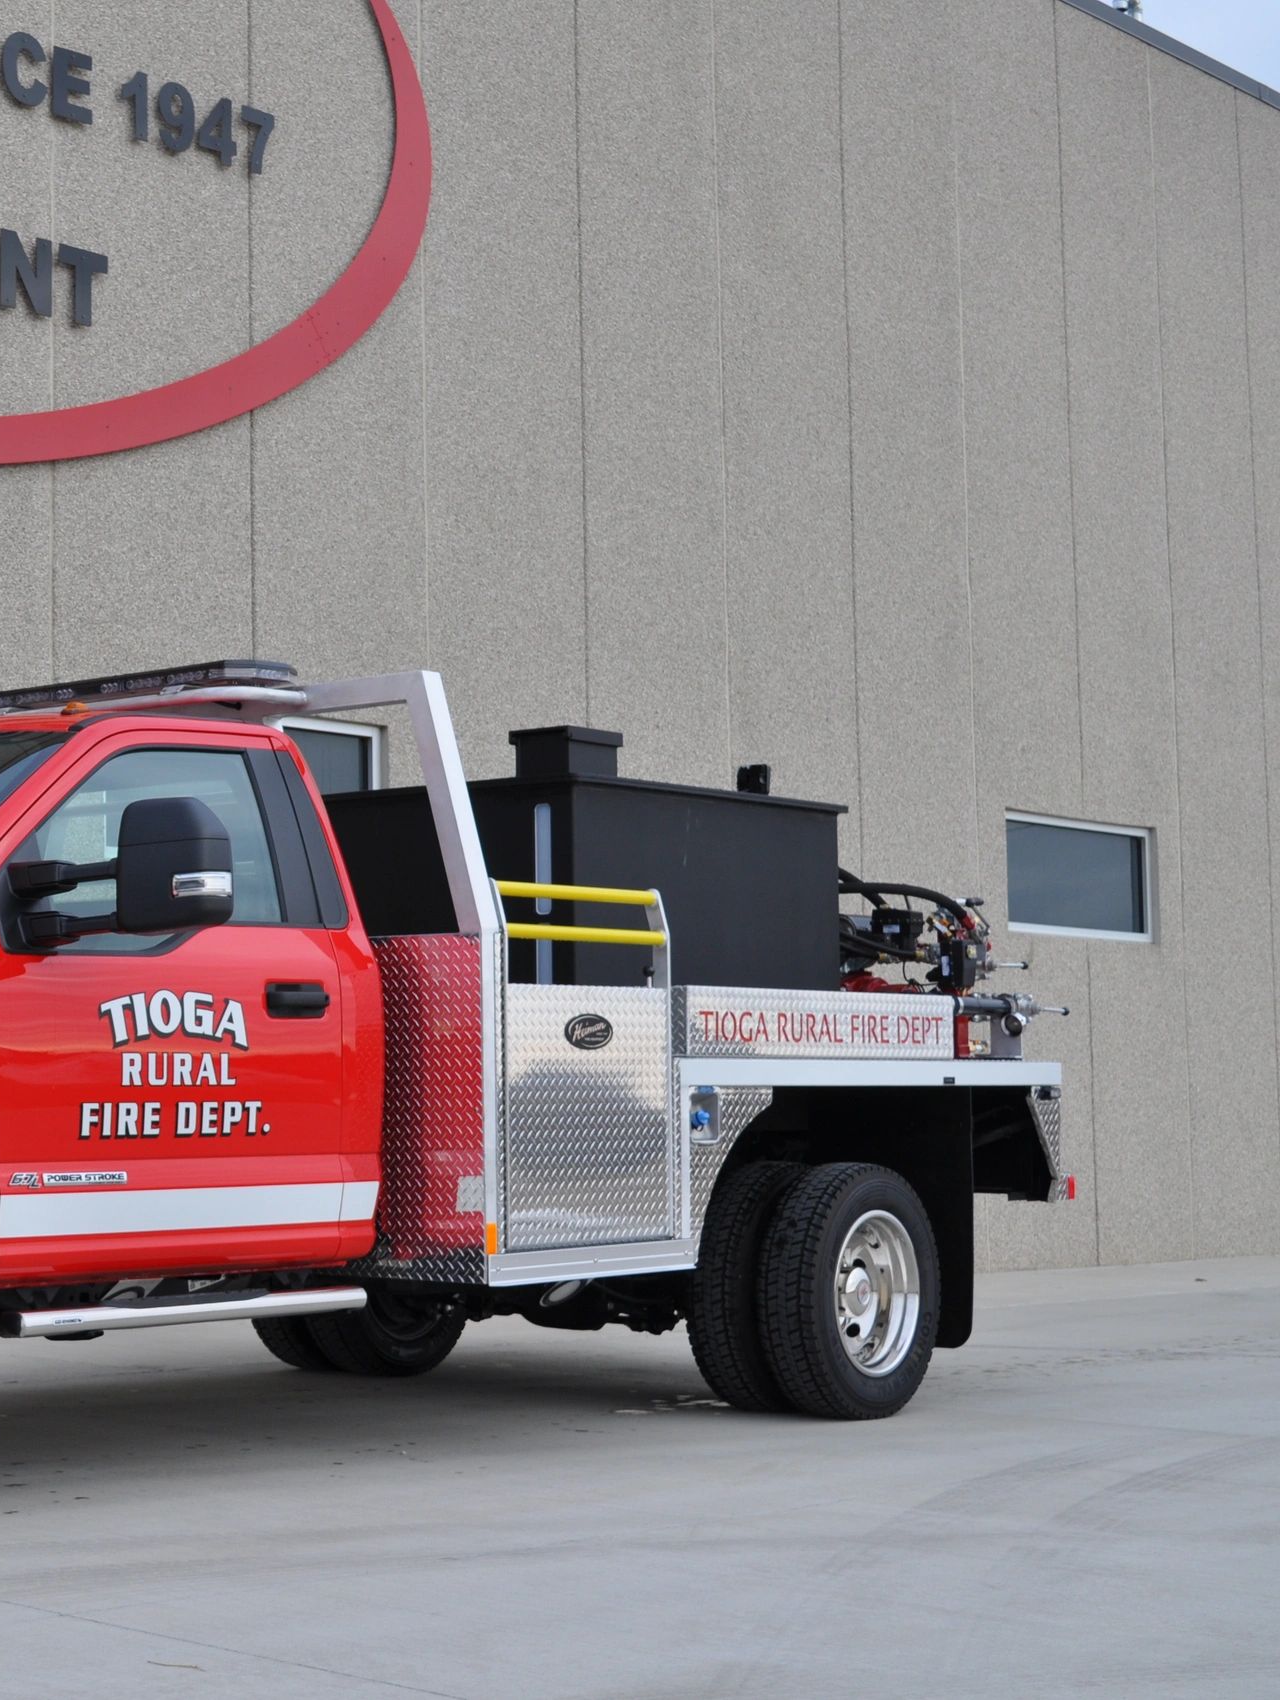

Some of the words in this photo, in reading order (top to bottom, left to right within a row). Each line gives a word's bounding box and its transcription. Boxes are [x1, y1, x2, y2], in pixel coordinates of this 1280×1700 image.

[121, 71, 276, 175] 1947
[99, 989, 249, 1050] TIOGA
[699, 1010, 769, 1043] TIOGA
[777, 1012, 844, 1043] RURAL
[851, 1014, 890, 1044] FIRE
[897, 1015, 944, 1045] DEPT
[121, 1052, 237, 1087] RURAL
[78, 1101, 162, 1140] FIRE
[174, 1101, 271, 1139] DEPT.
[47, 1174, 82, 1182] POWER
[85, 1173, 125, 1181] STROKE
